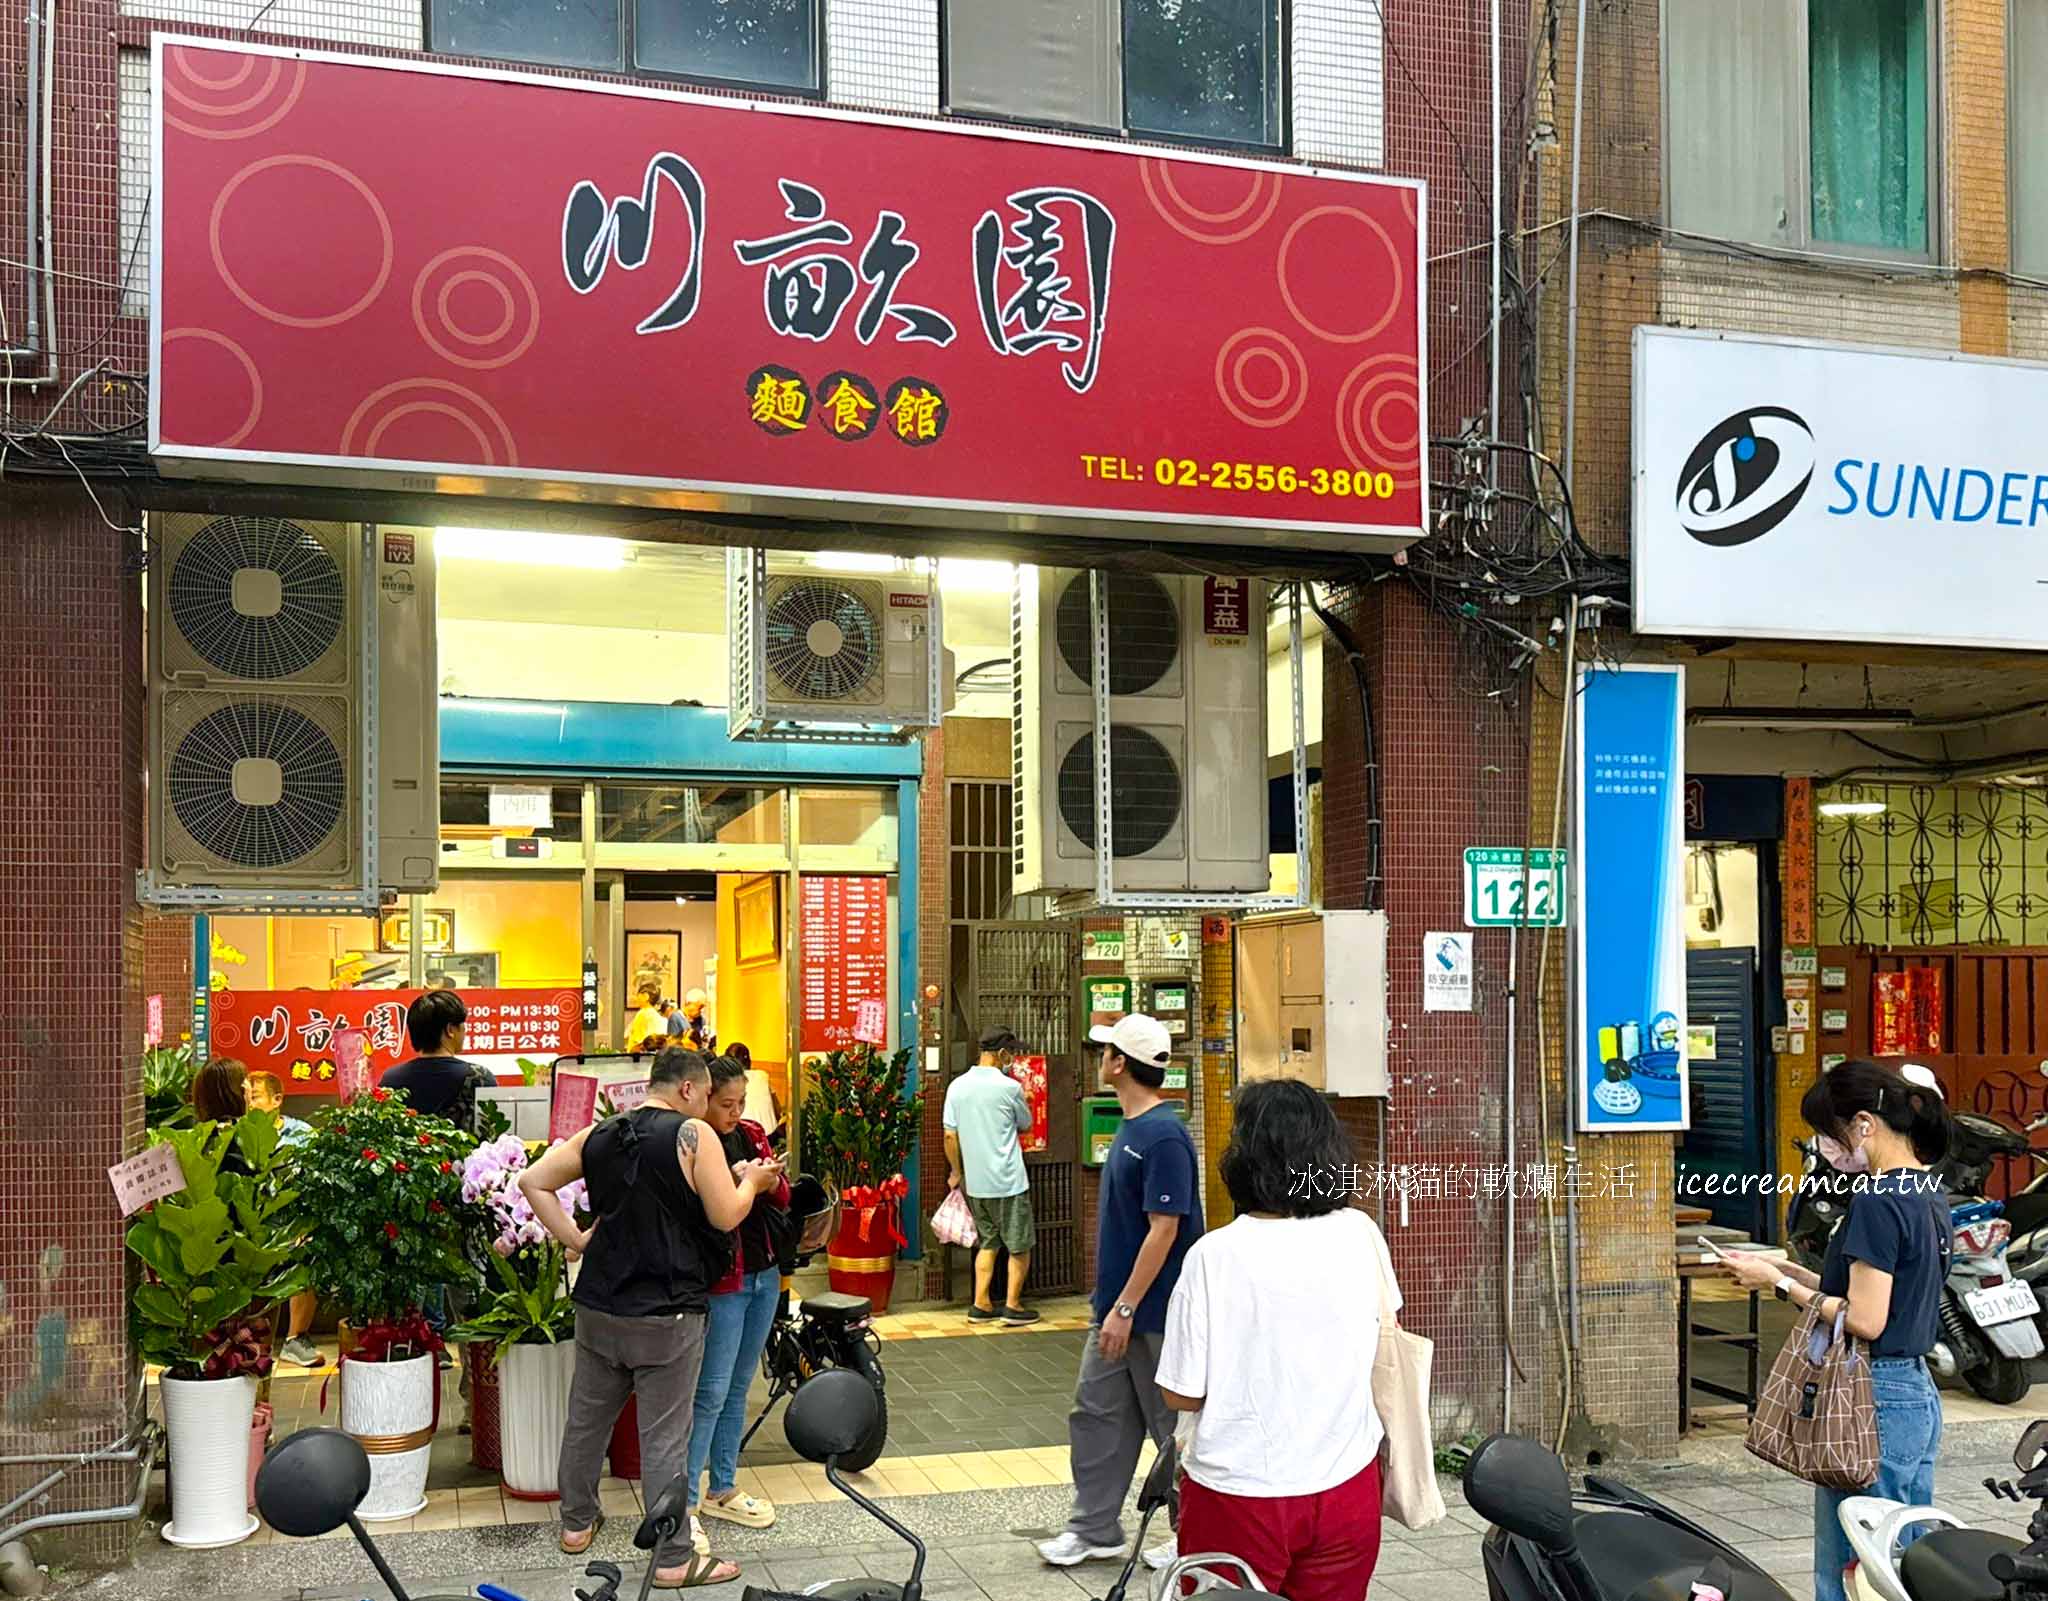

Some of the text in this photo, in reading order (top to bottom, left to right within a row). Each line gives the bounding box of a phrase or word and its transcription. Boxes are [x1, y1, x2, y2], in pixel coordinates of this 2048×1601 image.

[561, 151, 1116, 393] 川畝園
[750, 371, 943, 440] 麵食館
[1080, 455, 1395, 499] TEL: 02-2556-3800
[388, 551, 412, 562] IVX
[891, 596, 929, 606] HITACH
[1469, 851, 1488, 862] 120
[1547, 853, 1566, 863] 124
[1484, 879, 1554, 915] 122
[1097, 944, 1120, 957] 120
[1794, 959, 1814, 971] 122
[583, 971, 597, 1024] 營業中
[467, 1005, 497, 1017] :00-
